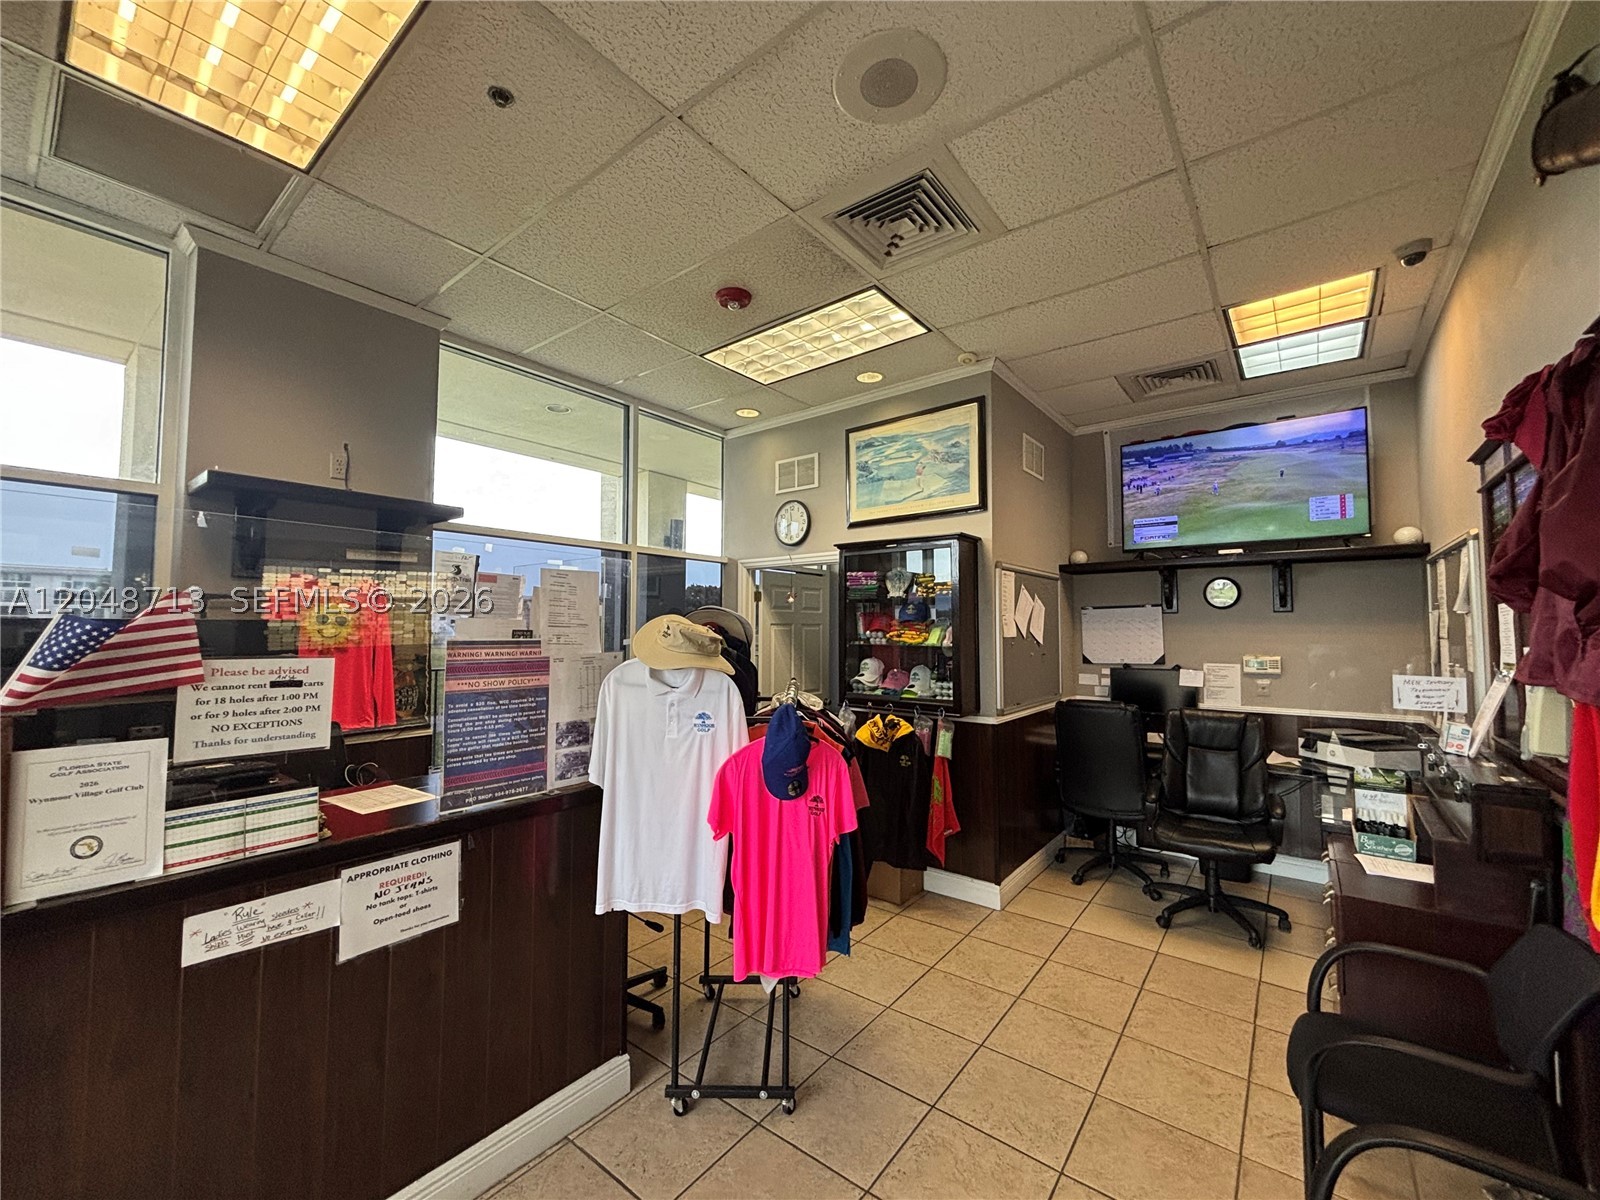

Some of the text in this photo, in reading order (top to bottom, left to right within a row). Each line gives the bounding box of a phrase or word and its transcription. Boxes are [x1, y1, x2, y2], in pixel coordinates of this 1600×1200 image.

[211, 666, 309, 677] Please be advised
[229, 695, 254, 704] holes
[232, 708, 257, 717] holes
[233, 719, 303, 731] EXCEPTIONS
[193, 739, 231, 749] Thanks
[251, 732, 316, 743] understanding
[75, 765, 130, 775] ASSOCIATION
[28, 794, 73, 804] Wynmoor
[346, 850, 452, 883] APPROPRIATE CLOTHING
[374, 888, 391, 900] NO
[379, 898, 395, 906] tank
[415, 886, 438, 896] T-shirts
[373, 904, 431, 925] Open-toed shoes
[204, 929, 232, 944] Ladies
